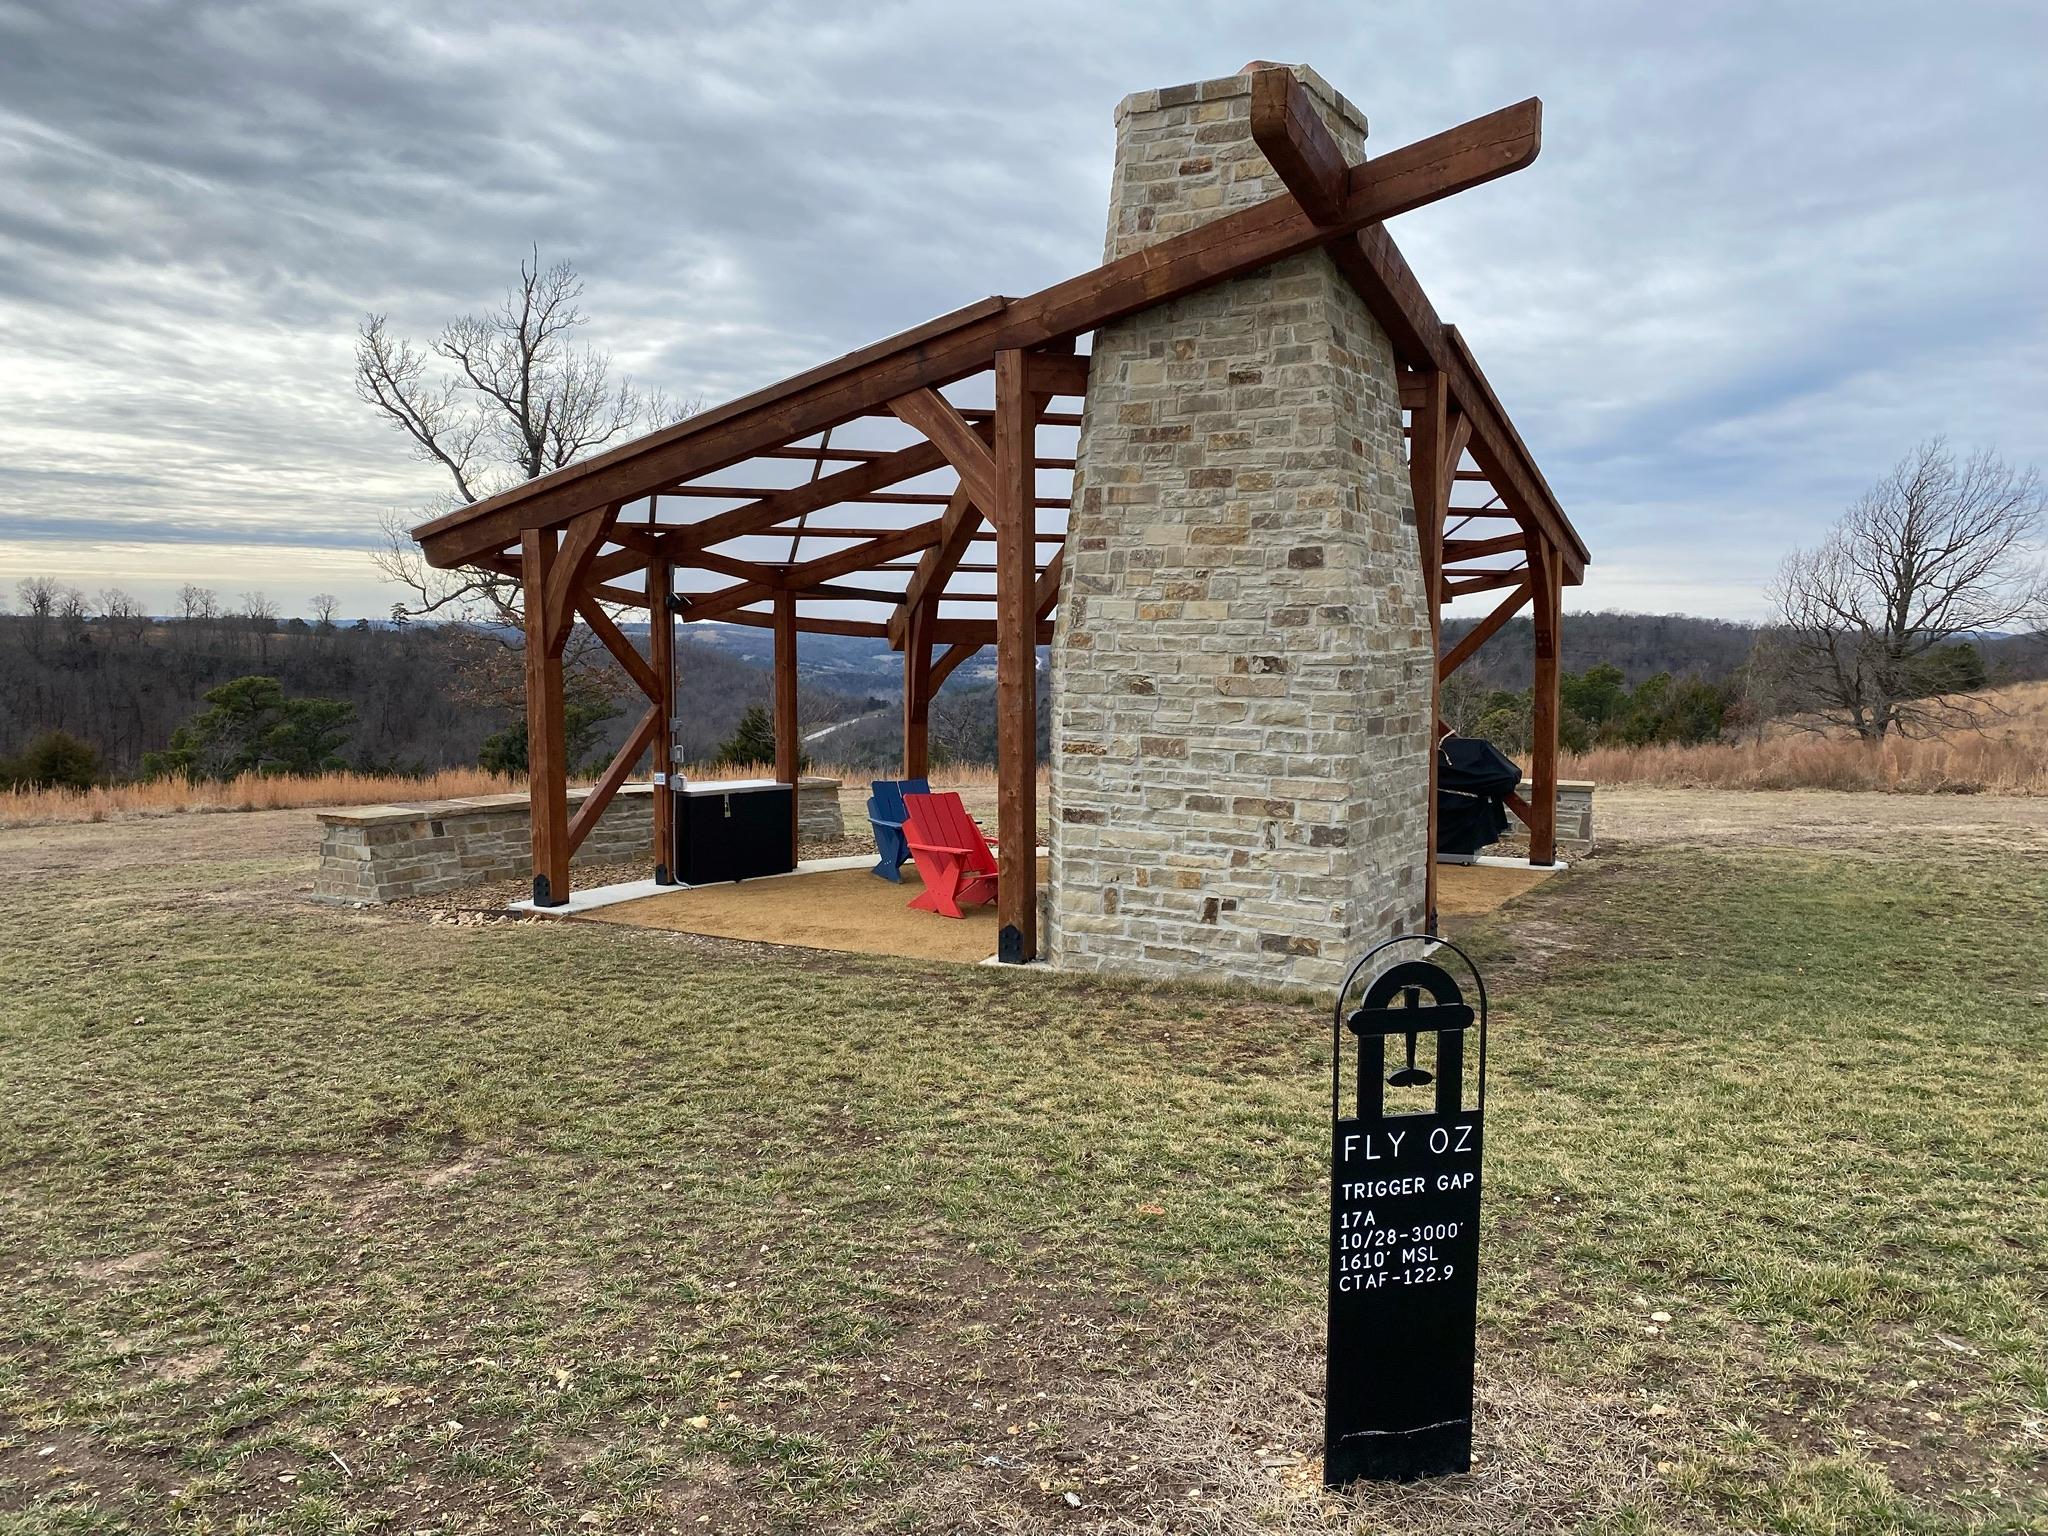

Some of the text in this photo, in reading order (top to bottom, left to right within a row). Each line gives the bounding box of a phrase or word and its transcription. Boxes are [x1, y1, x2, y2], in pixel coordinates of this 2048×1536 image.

[1344, 1125, 1473, 1162] FLY OZ
[1341, 1172, 1475, 1201] TRIGGER GAP
[1340, 1210, 1376, 1229] 17A
[1339, 1245, 1439, 1272] 1610' MSL
